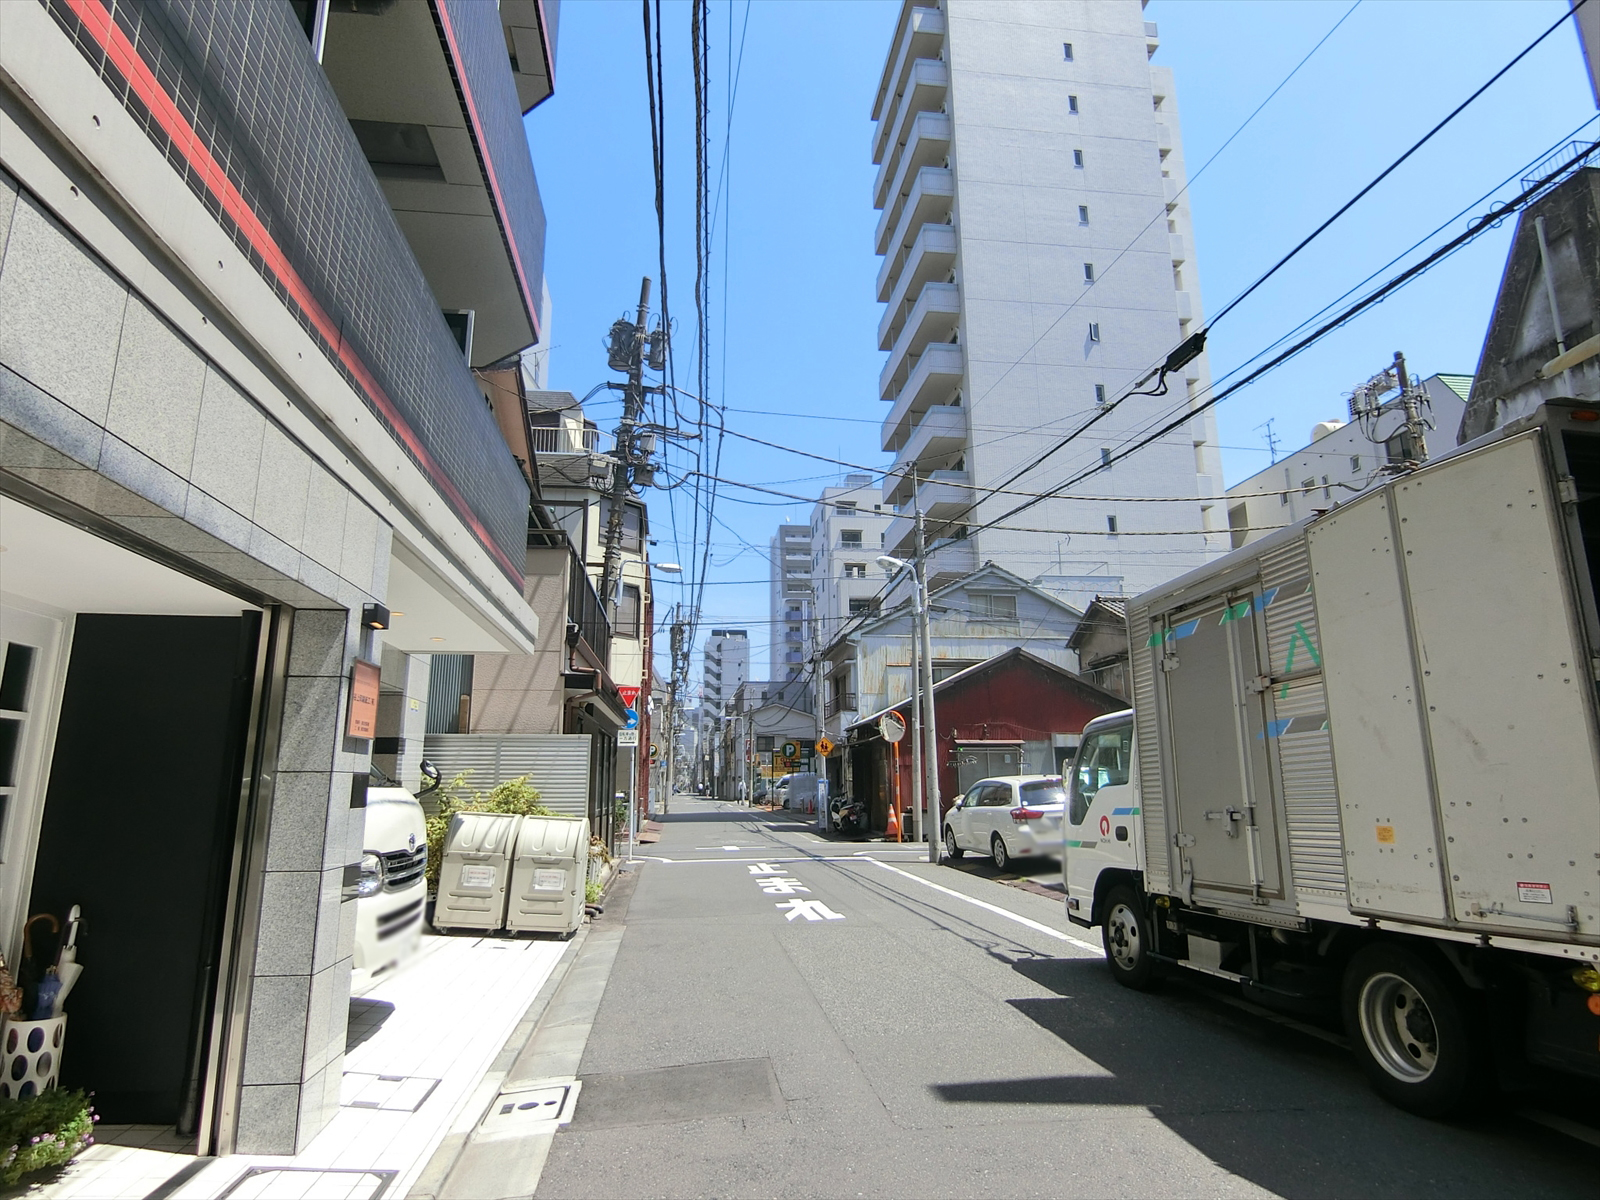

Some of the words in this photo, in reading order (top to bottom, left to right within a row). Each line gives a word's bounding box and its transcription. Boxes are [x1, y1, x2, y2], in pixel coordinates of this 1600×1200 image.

[785, 744, 795, 756] P
[747, 862, 847, 922] 止まれ
